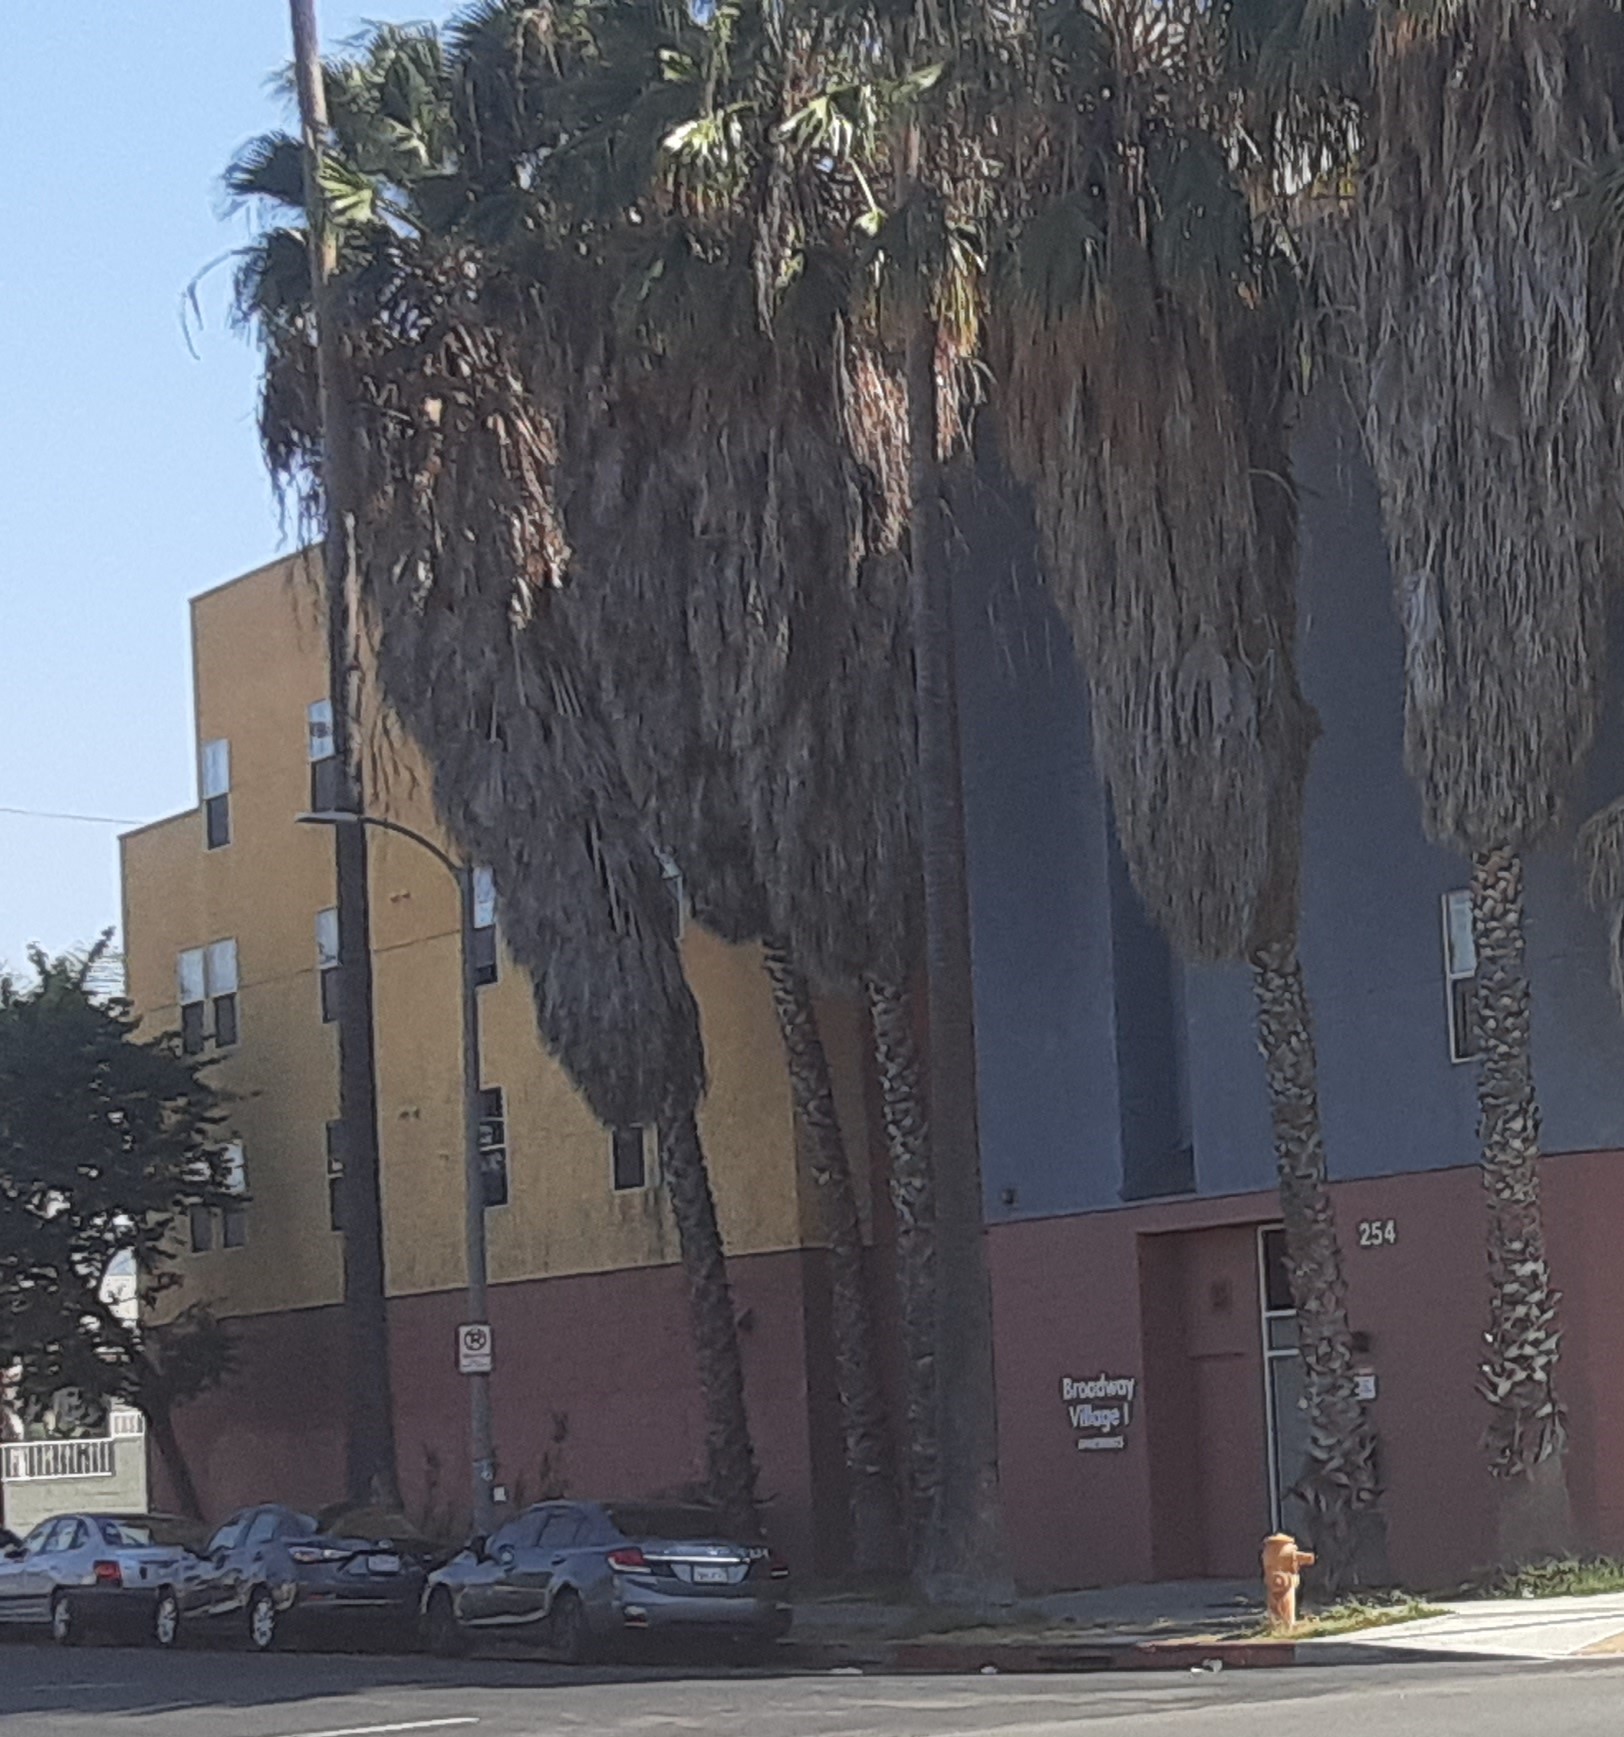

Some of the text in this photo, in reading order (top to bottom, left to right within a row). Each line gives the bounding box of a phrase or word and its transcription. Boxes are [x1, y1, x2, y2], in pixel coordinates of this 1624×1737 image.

[1359, 1219, 1396, 1246] 254
[1062, 1372, 1135, 1401] Broadway
[1068, 1403, 1121, 1433] Village
